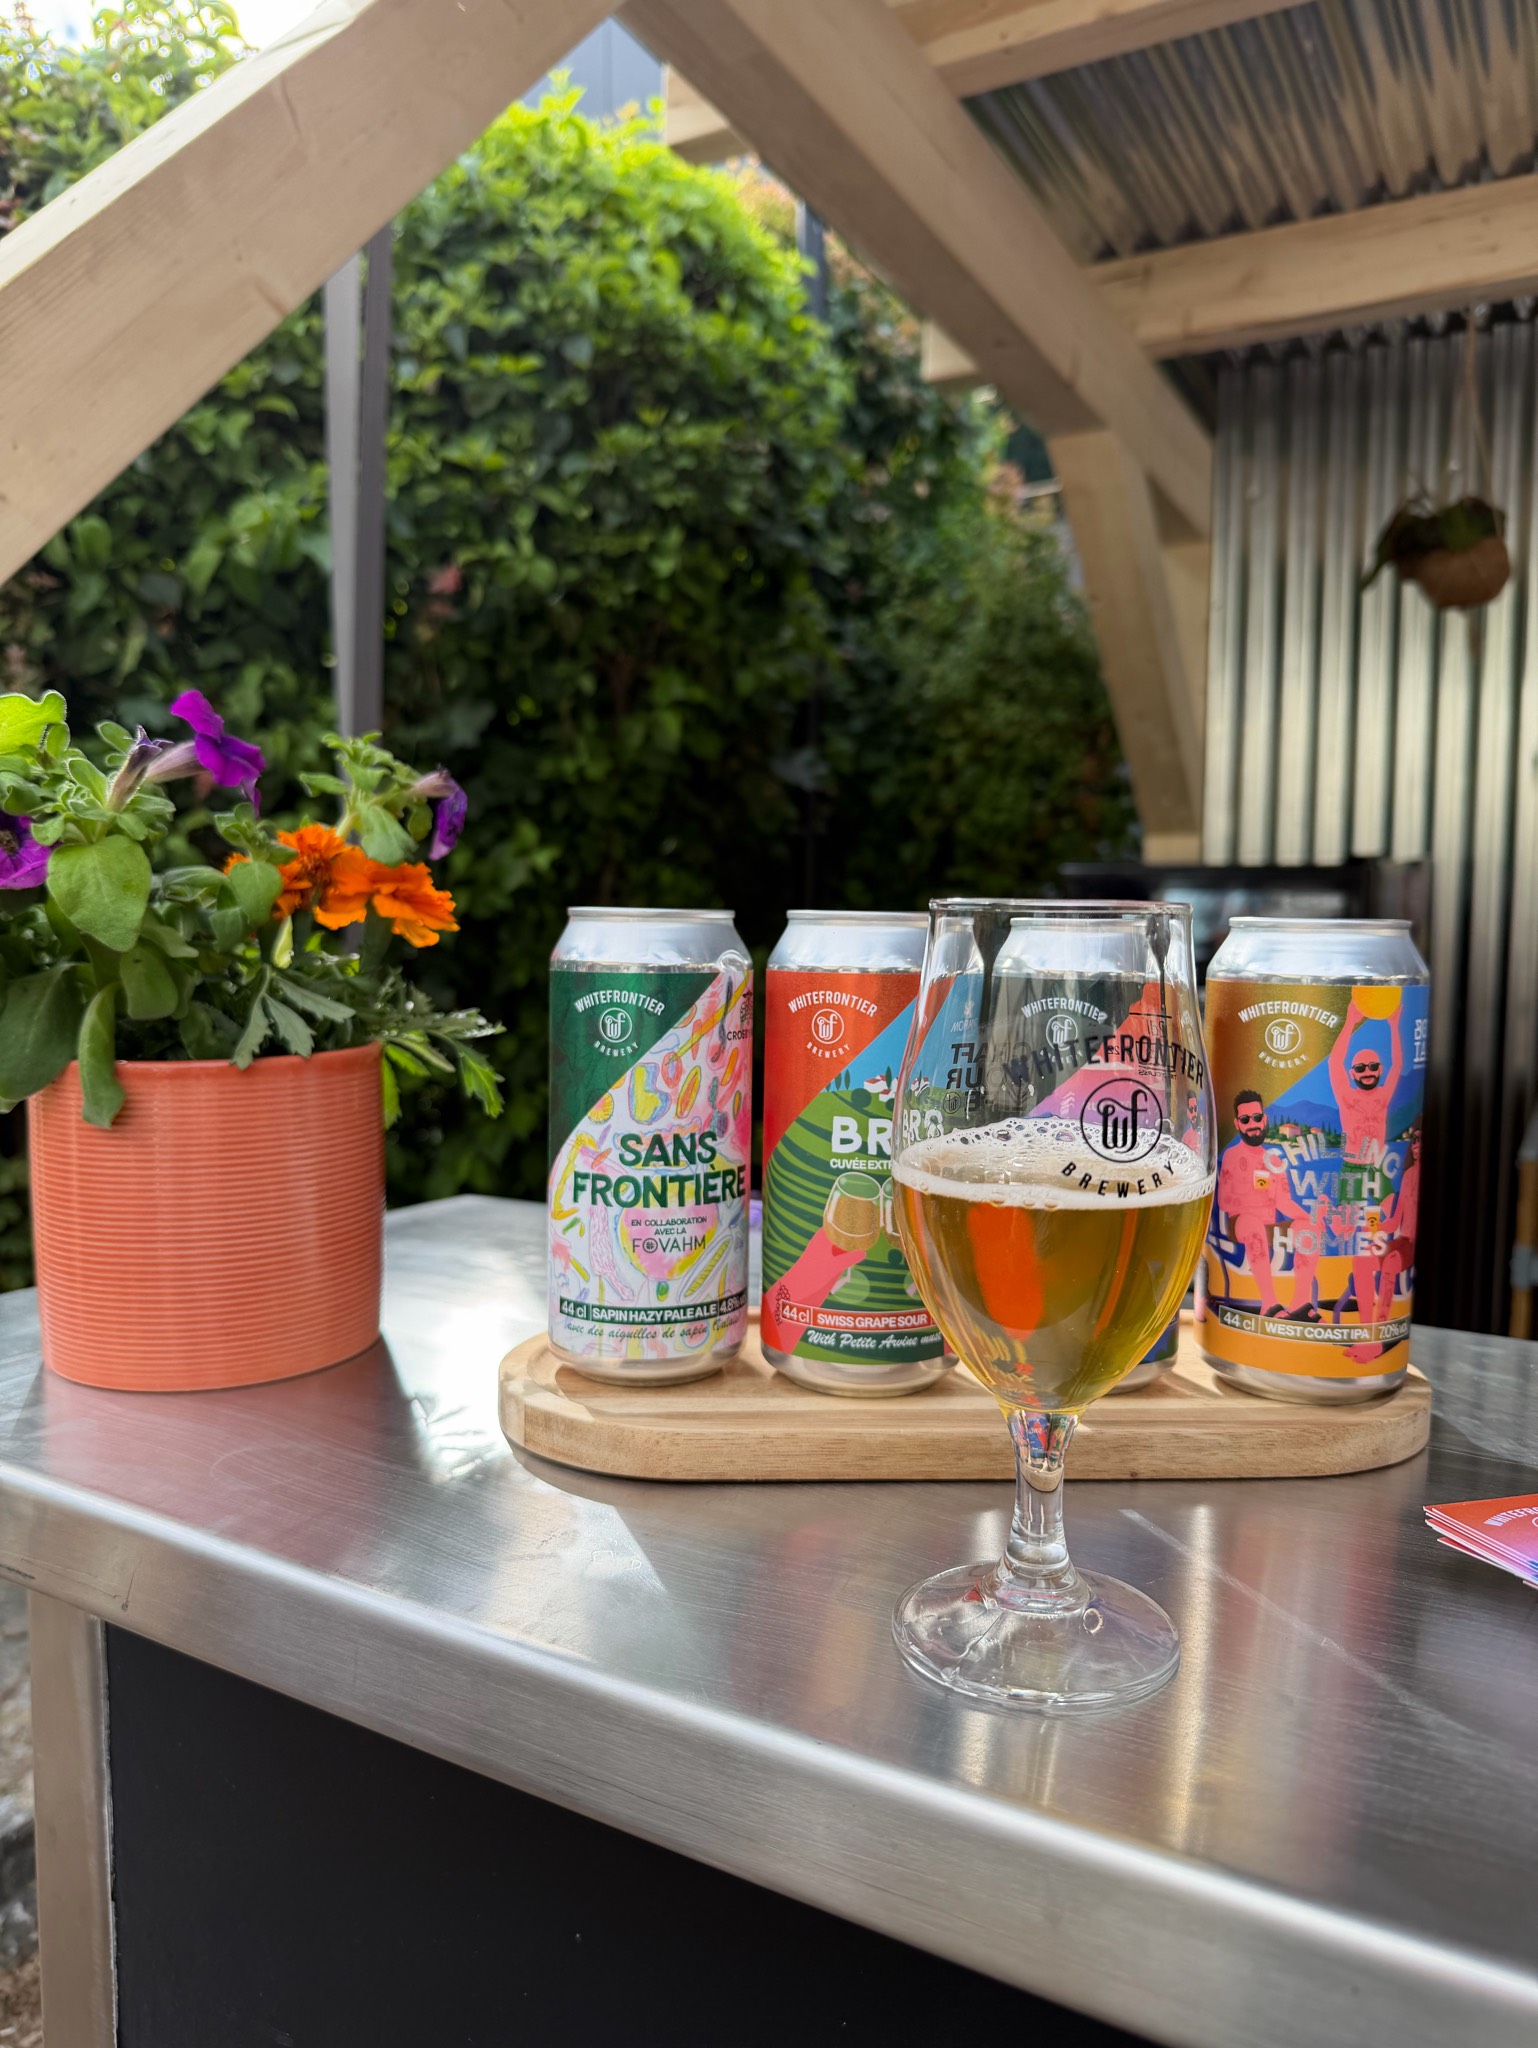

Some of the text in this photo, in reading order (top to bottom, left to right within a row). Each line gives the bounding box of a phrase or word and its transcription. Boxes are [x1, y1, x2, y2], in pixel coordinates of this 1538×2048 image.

[574, 990, 665, 1016] WHITEFRONTIER
[787, 990, 878, 1018] WHITEFRONTIER
[1238, 1000, 1339, 1029] WHITEFRONTIER
[593, 1041, 639, 1057] BREWERY
[806, 1041, 850, 1059] BREWERY
[1002, 1034, 1204, 1089] WHITEFRONTIER
[1258, 1051, 1308, 1069] BREWERY
[618, 1131, 718, 1167] SANS
[829, 1157, 866, 1170] CUVÉE
[573, 1164, 746, 1208] FRONTIÈRE
[1061, 1160, 1175, 1198] BREWERY
[1290, 1168, 1380, 1198] WITH
[631, 1216, 708, 1227] EN COLLABORATION
[1302, 1198, 1367, 1227] THE
[654, 1227, 687, 1236] AVEC LA
[1273, 1226, 1389, 1256] HOMIES
[562, 1300, 587, 1318] 44 cl
[592, 1303, 718, 1322] SAPIN HAZY PALE ALE
[782, 1305, 810, 1324] 44 cl
[817, 1313, 928, 1329] SWISS GRAPE SOUR
[1223, 1311, 1255, 1332] 44 cl
[567, 1322, 584, 1334] avec
[588, 1324, 604, 1336] des
[608, 1327, 658, 1342] aiguilles
[662, 1326, 675, 1338] de
[680, 1324, 708, 1340] sapin
[806, 1329, 837, 1346] With
[839, 1333, 877, 1349] Petite
[878, 1333, 918, 1349] Arvine
[1265, 1323, 1370, 1340] WEST COAST IPA
